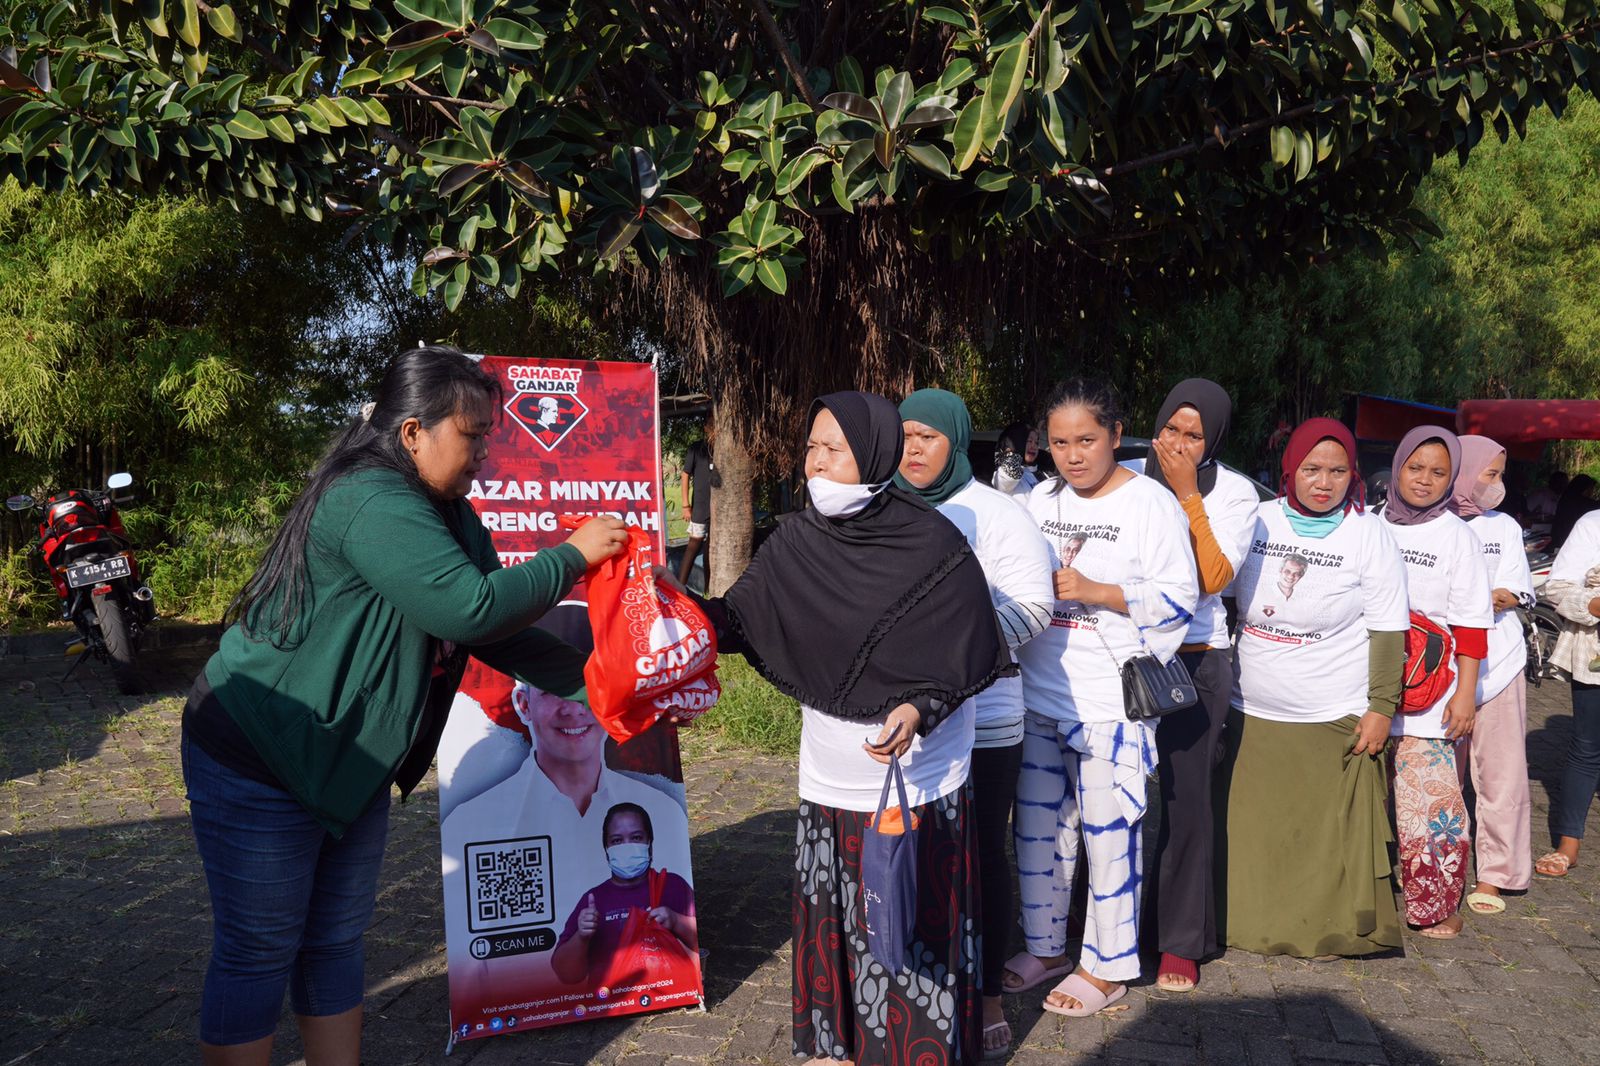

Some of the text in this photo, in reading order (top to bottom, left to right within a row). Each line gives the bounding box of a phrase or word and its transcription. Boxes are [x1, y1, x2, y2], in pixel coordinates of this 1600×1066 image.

[509, 367, 580, 381] SAHABAT
[515, 380, 576, 392] GANJAR
[465, 480, 651, 500] AZAR MINYAK
[482, 511, 557, 531] RENG
[1043, 519, 1121, 534] SAHABAT GANJAR
[1041, 526, 1118, 542] SAHABA ANJAR
[1251, 547, 1342, 568] SAHABA ANJAR
[1254, 539, 1344, 562] SAHABAT GANJAR
[70, 559, 124, 578] K 4154 RR
[1403, 555, 1435, 568] ANJAR
[635, 628, 711, 676] GANJAR
[634, 647, 711, 691] PRAN
[494, 935, 545, 952] SCAN ME
[498, 997, 560, 1012] sahabatganjar.com
[612, 979, 673, 994] sahabatganjar2024
[522, 1009, 570, 1022] sahabatganjar
